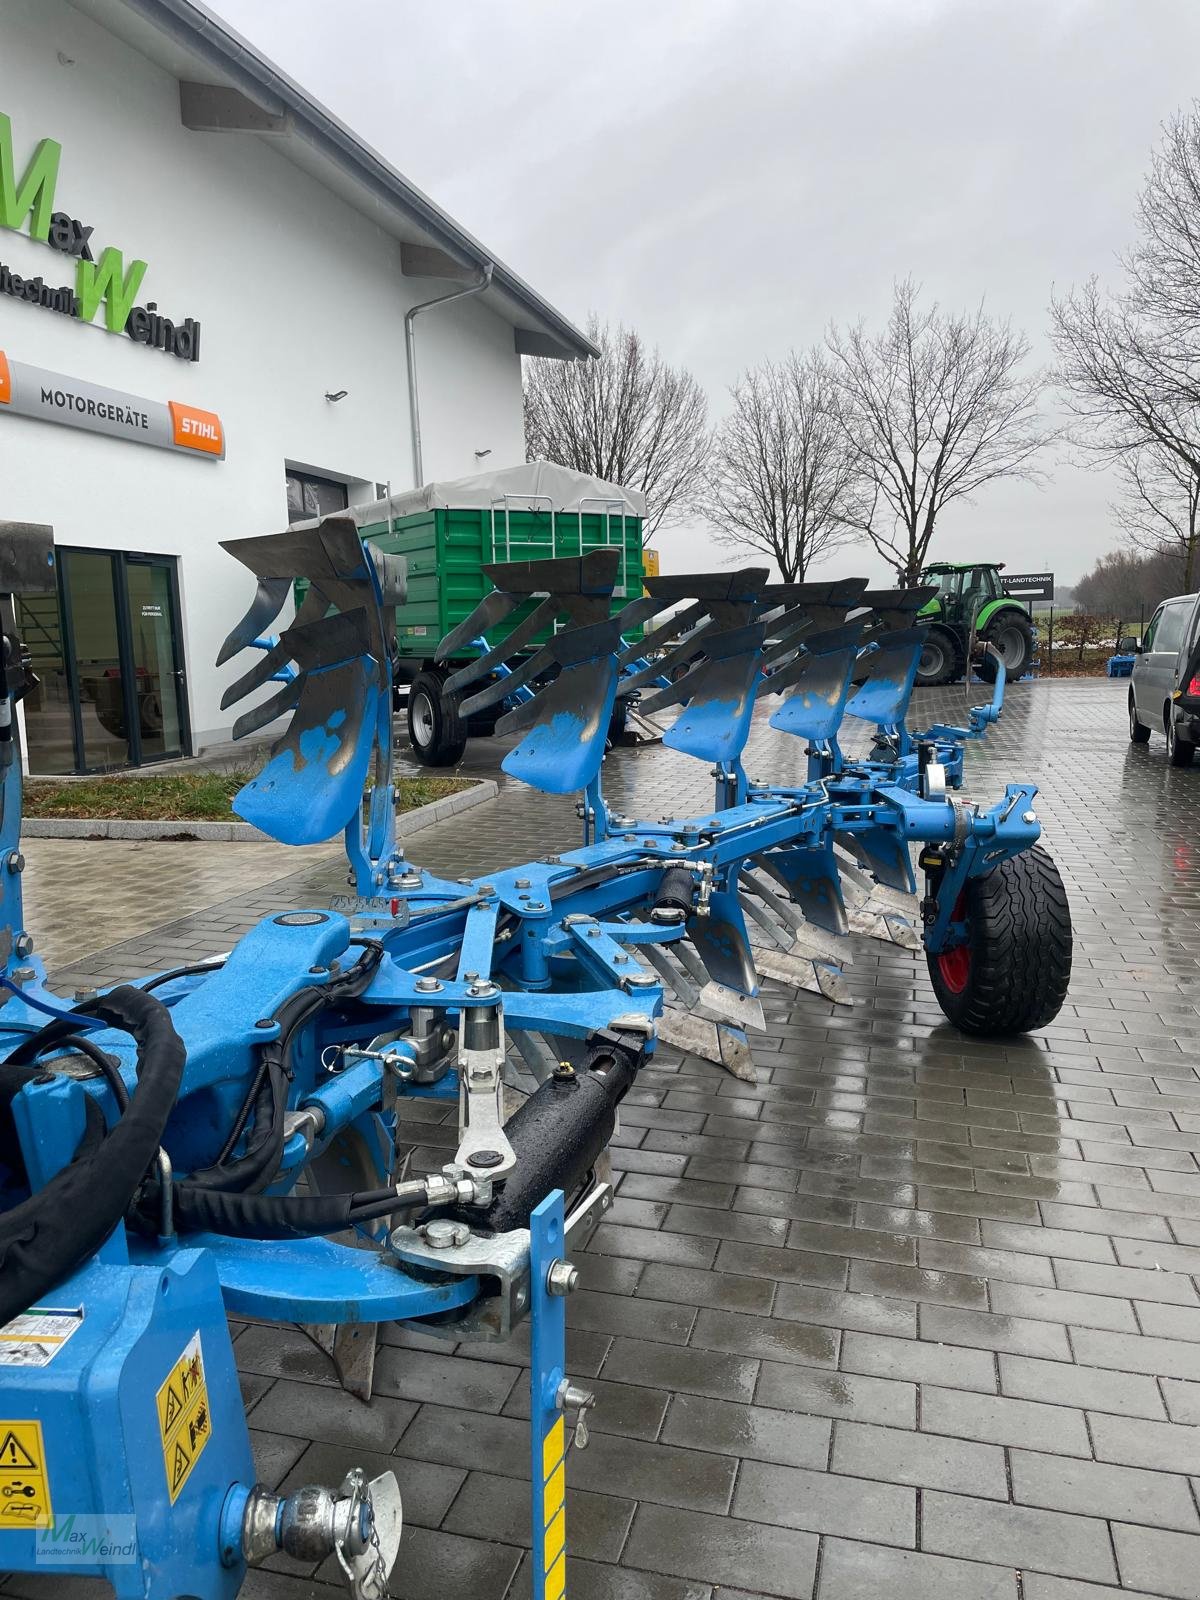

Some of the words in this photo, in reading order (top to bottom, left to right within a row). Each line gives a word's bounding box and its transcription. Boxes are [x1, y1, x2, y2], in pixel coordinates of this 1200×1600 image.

[0, 112, 94, 262] Max
[0, 262, 81, 318] technik
[77, 246, 200, 362] Weindl
[41, 386, 149, 429] MOTORGERÄTE
[182, 418, 219, 441] STIHL
